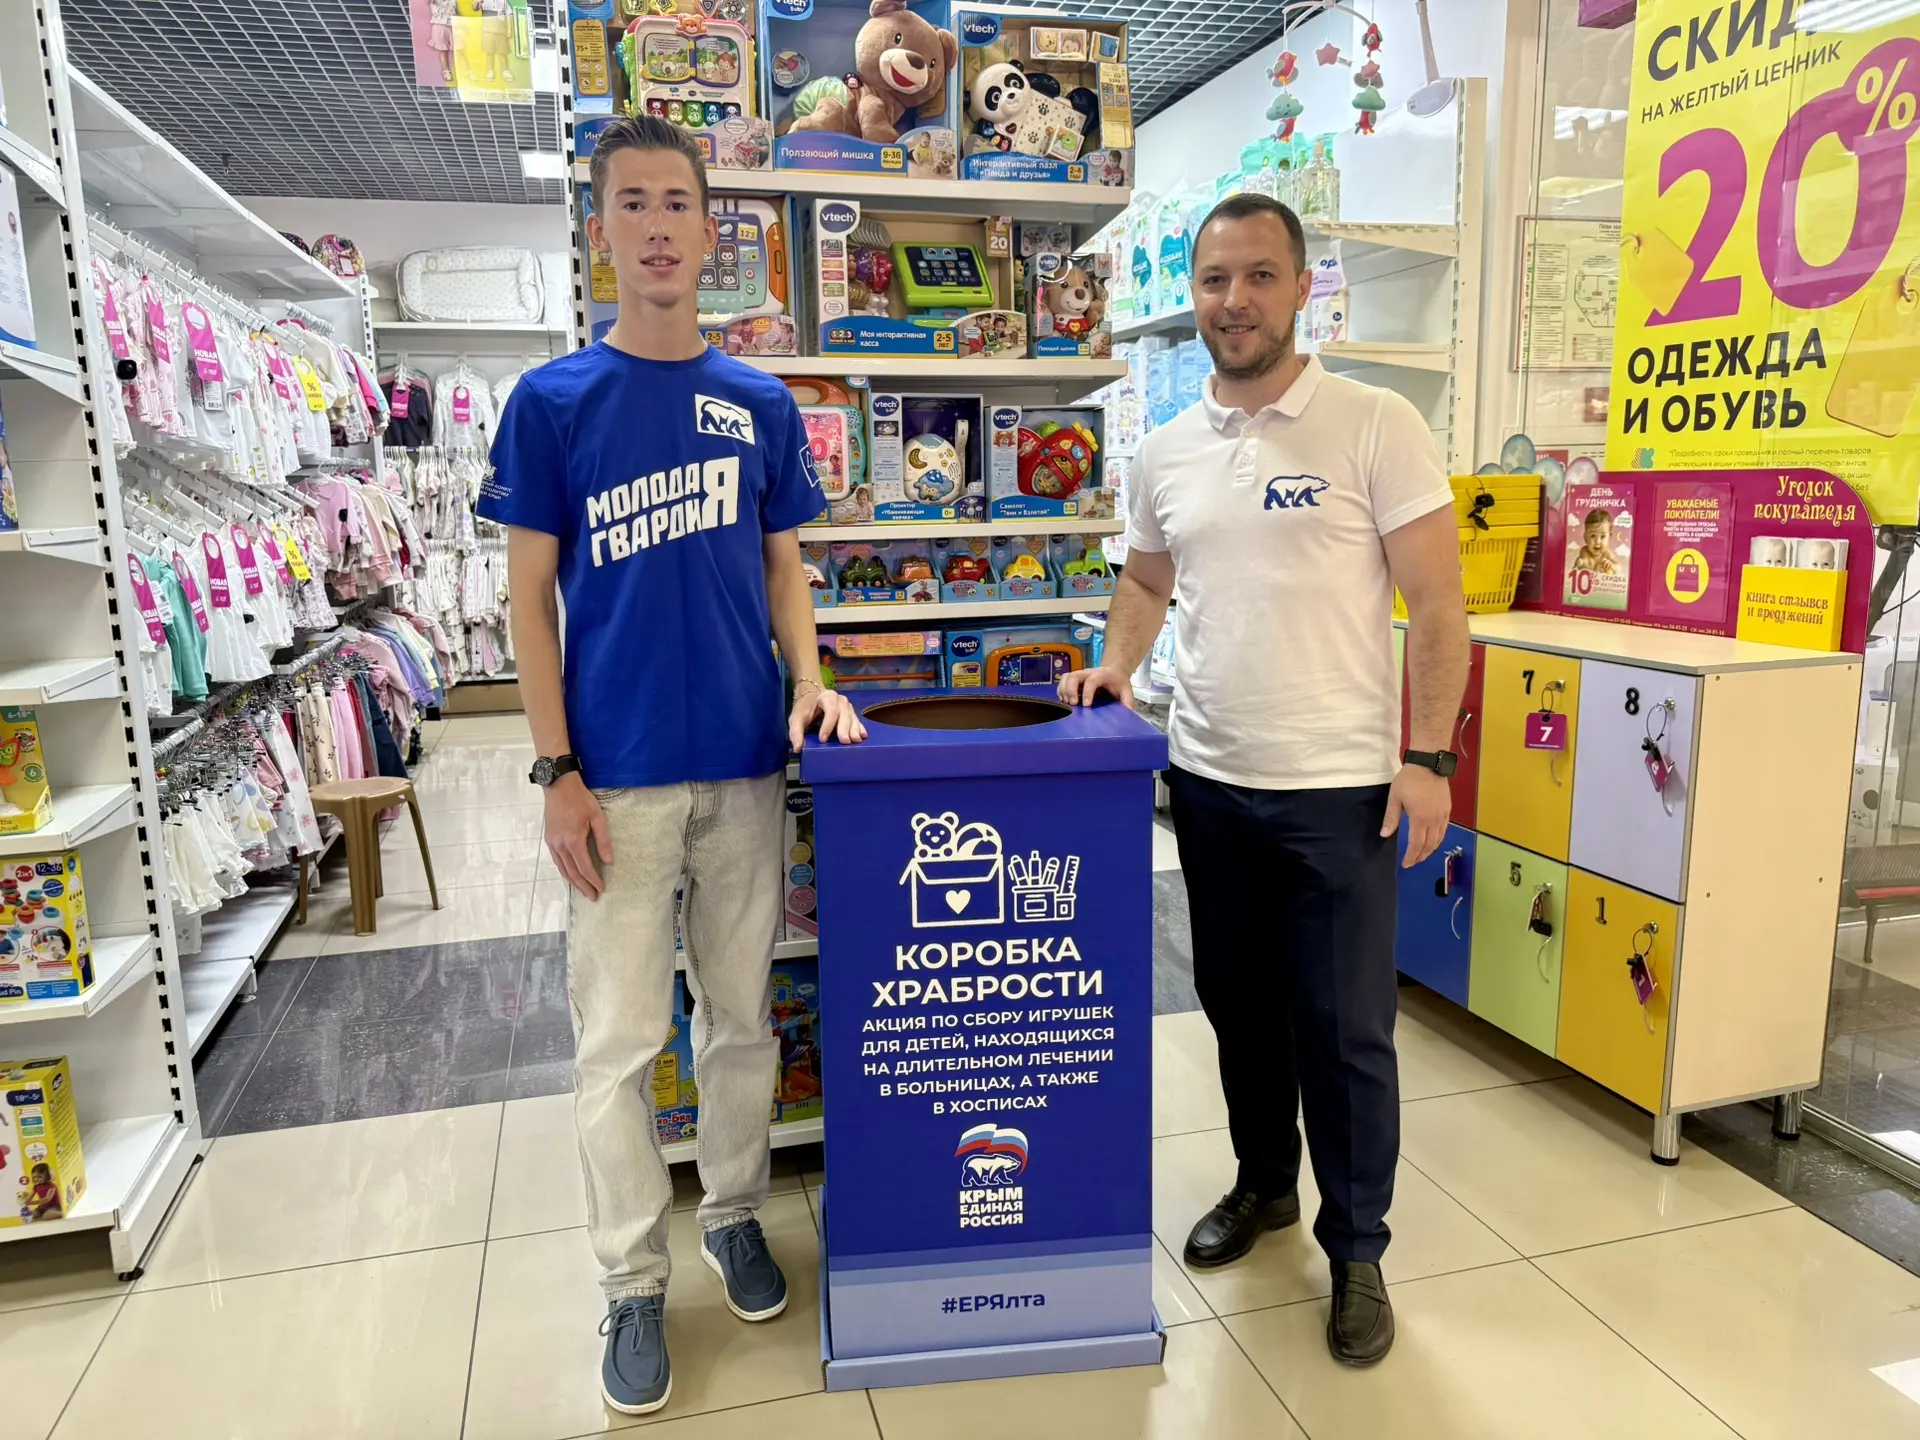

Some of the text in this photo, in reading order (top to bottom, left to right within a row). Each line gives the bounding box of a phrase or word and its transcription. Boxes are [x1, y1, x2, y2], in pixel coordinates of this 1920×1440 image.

[963, 22, 996, 35] vtech
[1641, 40, 1843, 124] НА ЖЕЛТЫЙ ЦЕННИК
[781, 147, 874, 160] Ползающий мишка
[883, 151, 901, 159] 9-36
[972, 159, 1058, 170] Интерактивный пазл
[1070, 166, 1082, 174] 2-4
[822, 212, 855, 223] vtech
[991, 236, 1008, 249] 20
[707, 332, 721, 341] 2-5
[937, 334, 951, 342] 2-5
[194, 349, 217, 359] НОВАЯ
[1627, 328, 1826, 387] ОДЕЖДА
[1623, 388, 1806, 434] И ОБУВЬ
[1841, 447, 1871, 455] товаров
[1590, 487, 1613, 497] ДЕНЬ
[1776, 476, 1835, 503] Уголок
[1575, 498, 1626, 508] ГРУДНИЧКА
[1666, 499, 1718, 508] УВАЖАЕМЫЕ
[1664, 510, 1720, 519] ПОКУПАТЕЛИ!
[1754, 503, 1856, 527] покупателя
[209, 578, 227, 586] НОВАЯ
[1746, 592, 1828, 609] книга отзывов
[1748, 607, 1754, 616] и
[953, 639, 978, 648] vtech
[1522, 669, 1535, 695] 7
[1625, 687, 1640, 715] 8
[1540, 726, 1553, 742] 7
[29, 769, 36, 777] 6
[16, 869, 33, 877] 2in1
[36, 863, 62, 873] 12-36
[1510, 862, 1521, 887] 5
[1596, 897, 1607, 925] 1
[895, 936, 1082, 971] КОРОБКА
[872, 970, 1103, 1008] ХРАБРОСТИ
[862, 1006, 1114, 1033] АКЦИЯ ПО СБОРУ ИГРУШЕК
[861, 1027, 1115, 1057] ДЛЯ ДЕТЕЙ, НАХОДЯЩИХСЯ
[864, 1048, 1114, 1076] НА ДЛИТЕЛЬНОМ ЛЕЧЕНИИ
[880, 1071, 1099, 1097] В БОЛЬНИЦАХ, А ТАКЖЕ
[933, 1095, 1048, 1115] В ХОСПИСАХ
[656, 1112, 692, 1126] ип-Бип
[959, 1186, 1023, 1204] КРЫМ
[959, 1201, 1023, 1216] ЕДИНАЯ
[960, 1213, 1023, 1229] РОССИЯ
[941, 1293, 1046, 1314] #ЕРЯлта
